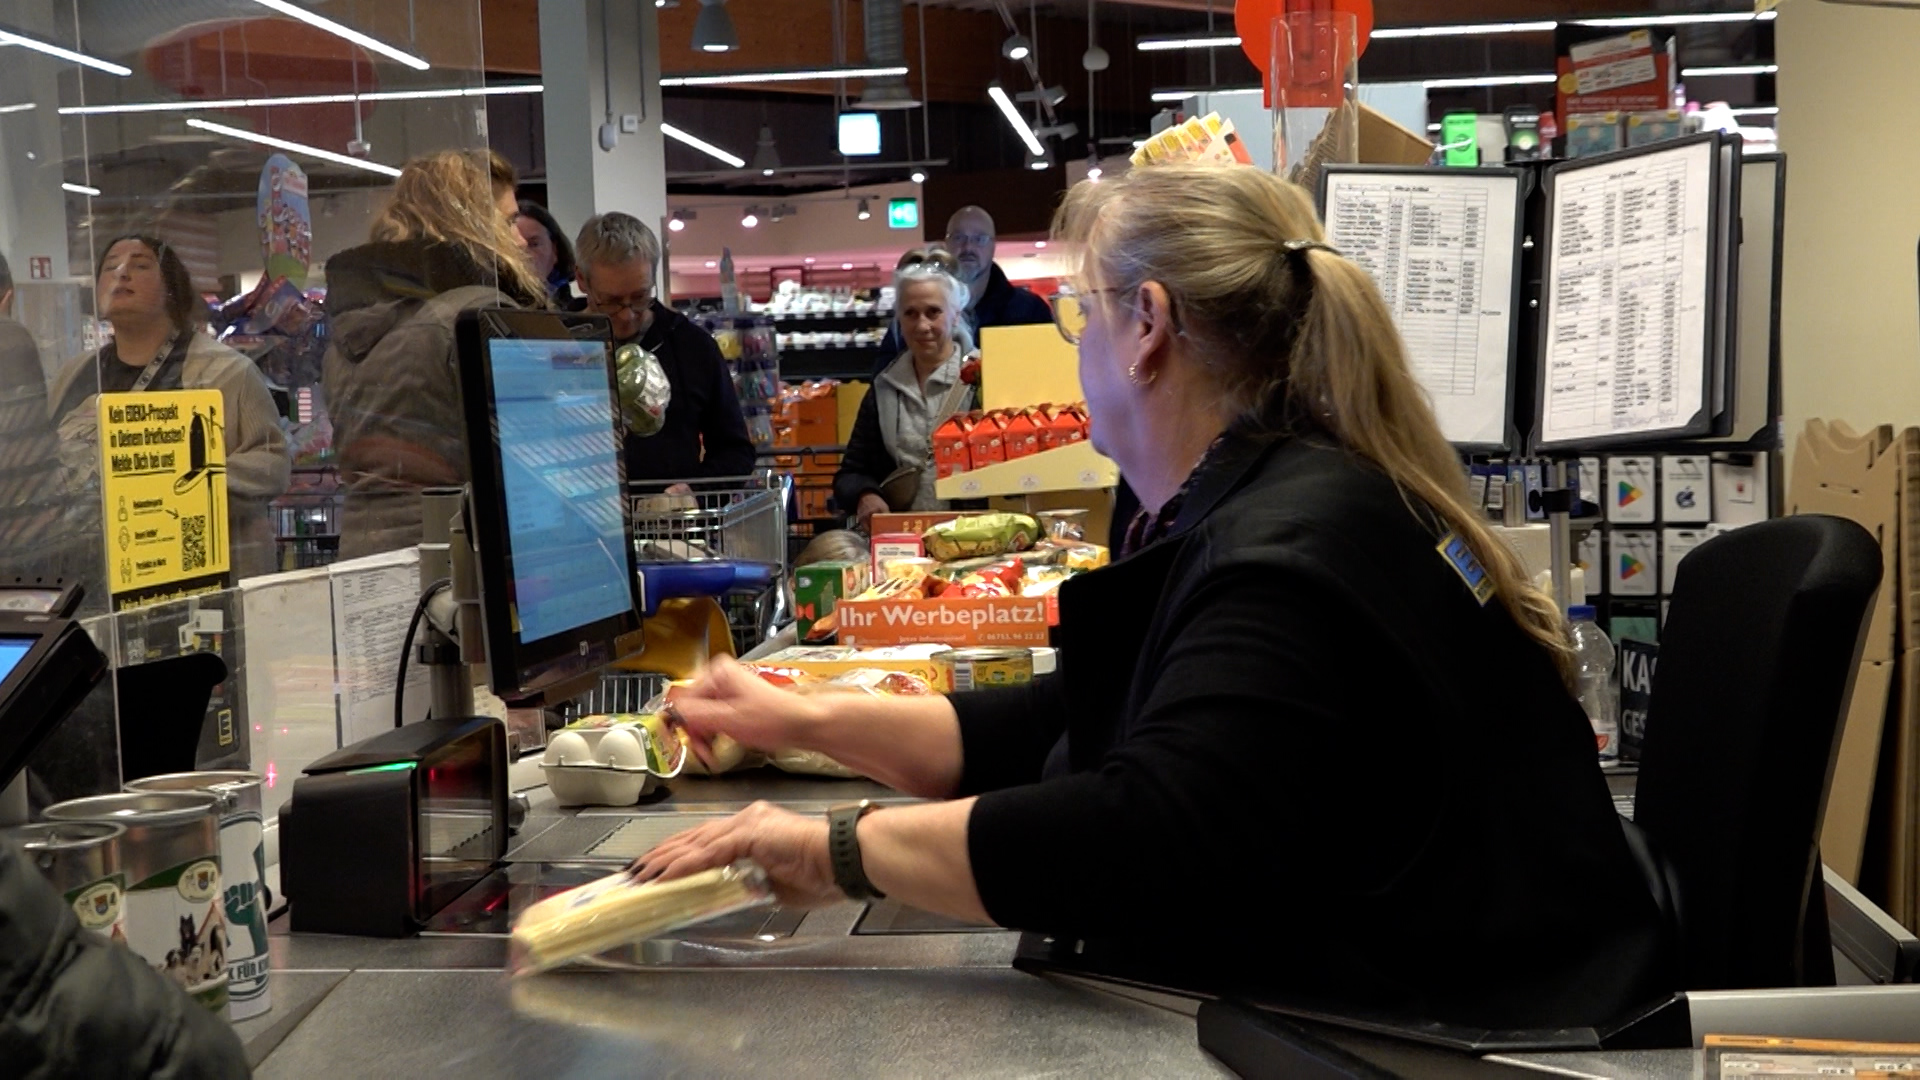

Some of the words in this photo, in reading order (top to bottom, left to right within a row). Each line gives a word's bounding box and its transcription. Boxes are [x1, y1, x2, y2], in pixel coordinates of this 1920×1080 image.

[108, 405, 124, 423] Kein
[109, 430, 117, 448] in
[118, 429, 143, 447] Deinem
[144, 425, 186, 445] Briefkasten?
[112, 454, 132, 472] Melde
[133, 452, 149, 470] Dich
[149, 452, 160, 469] bei
[841, 606, 878, 626] Ihr
[881, 601, 1044, 630] Werbeplatz!
[237, 960, 256, 979] FÜR
